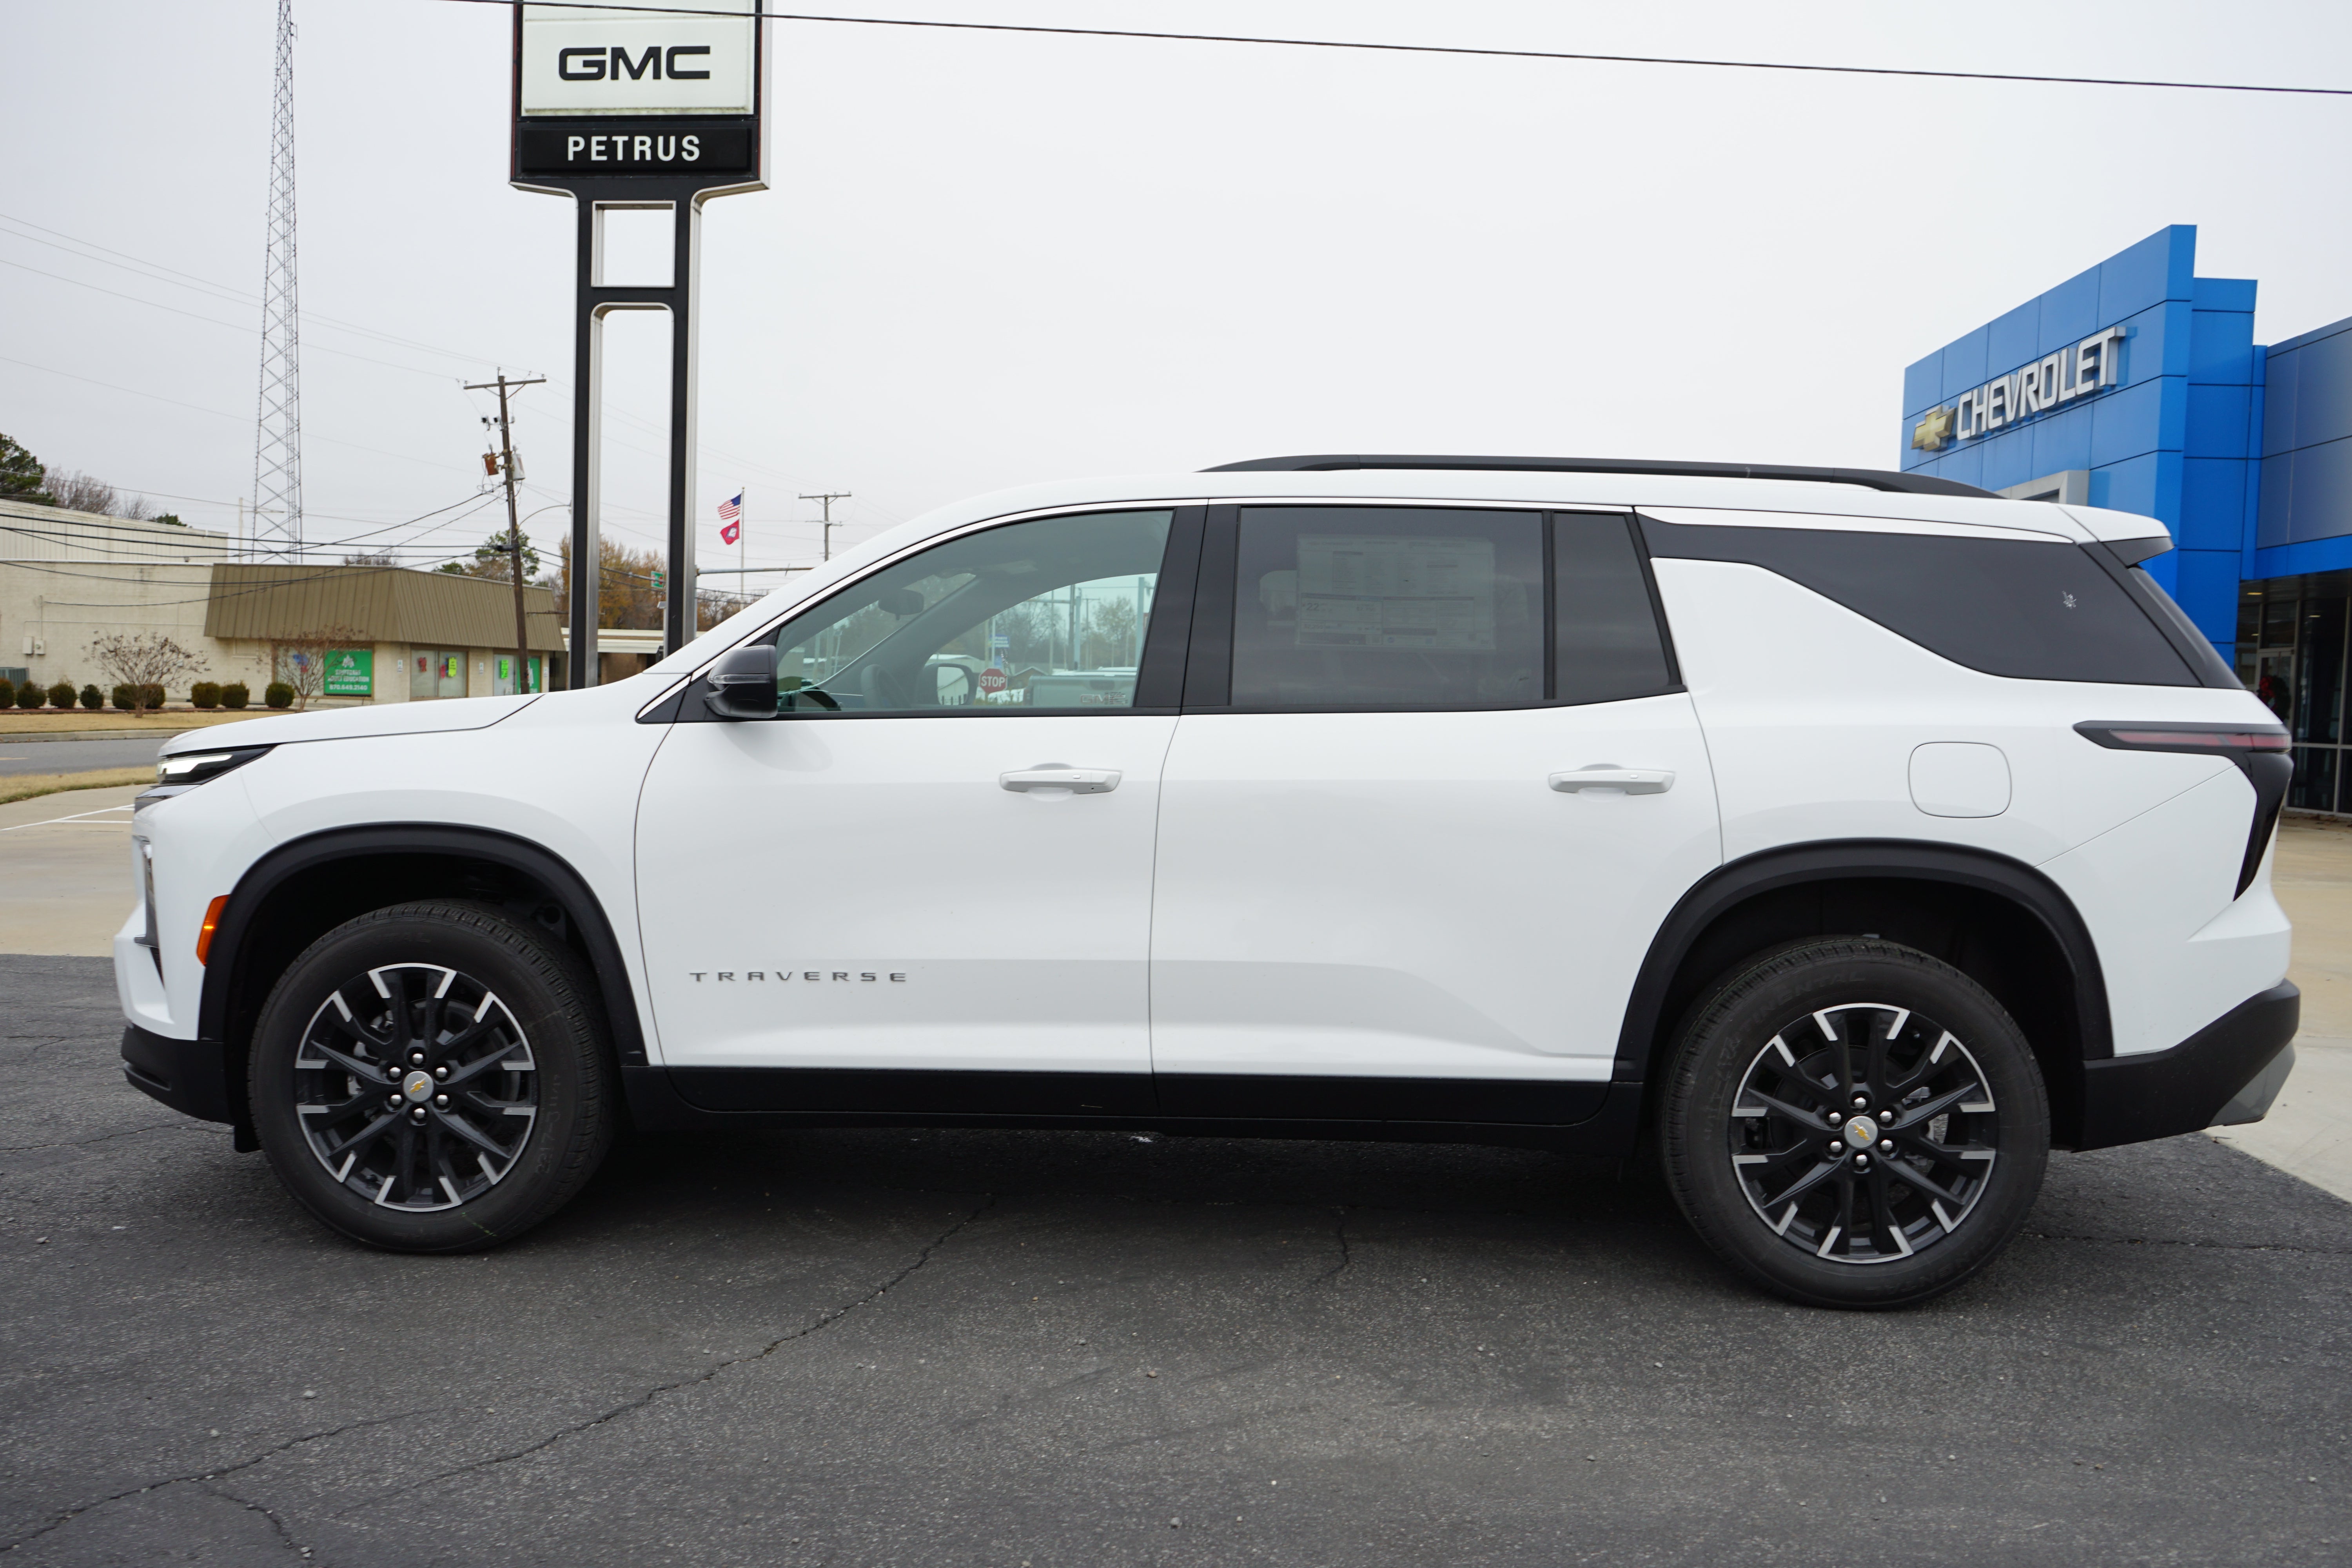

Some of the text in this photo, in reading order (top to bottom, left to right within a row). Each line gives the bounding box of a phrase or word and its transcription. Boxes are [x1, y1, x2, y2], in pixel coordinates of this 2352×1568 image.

[559, 45, 710, 80] GMC
[568, 136, 700, 161] PETRUS
[1956, 326, 2126, 441] CHEVROLET
[981, 676, 1005, 687] STOP
[690, 971, 906, 982] TRAVERSE
